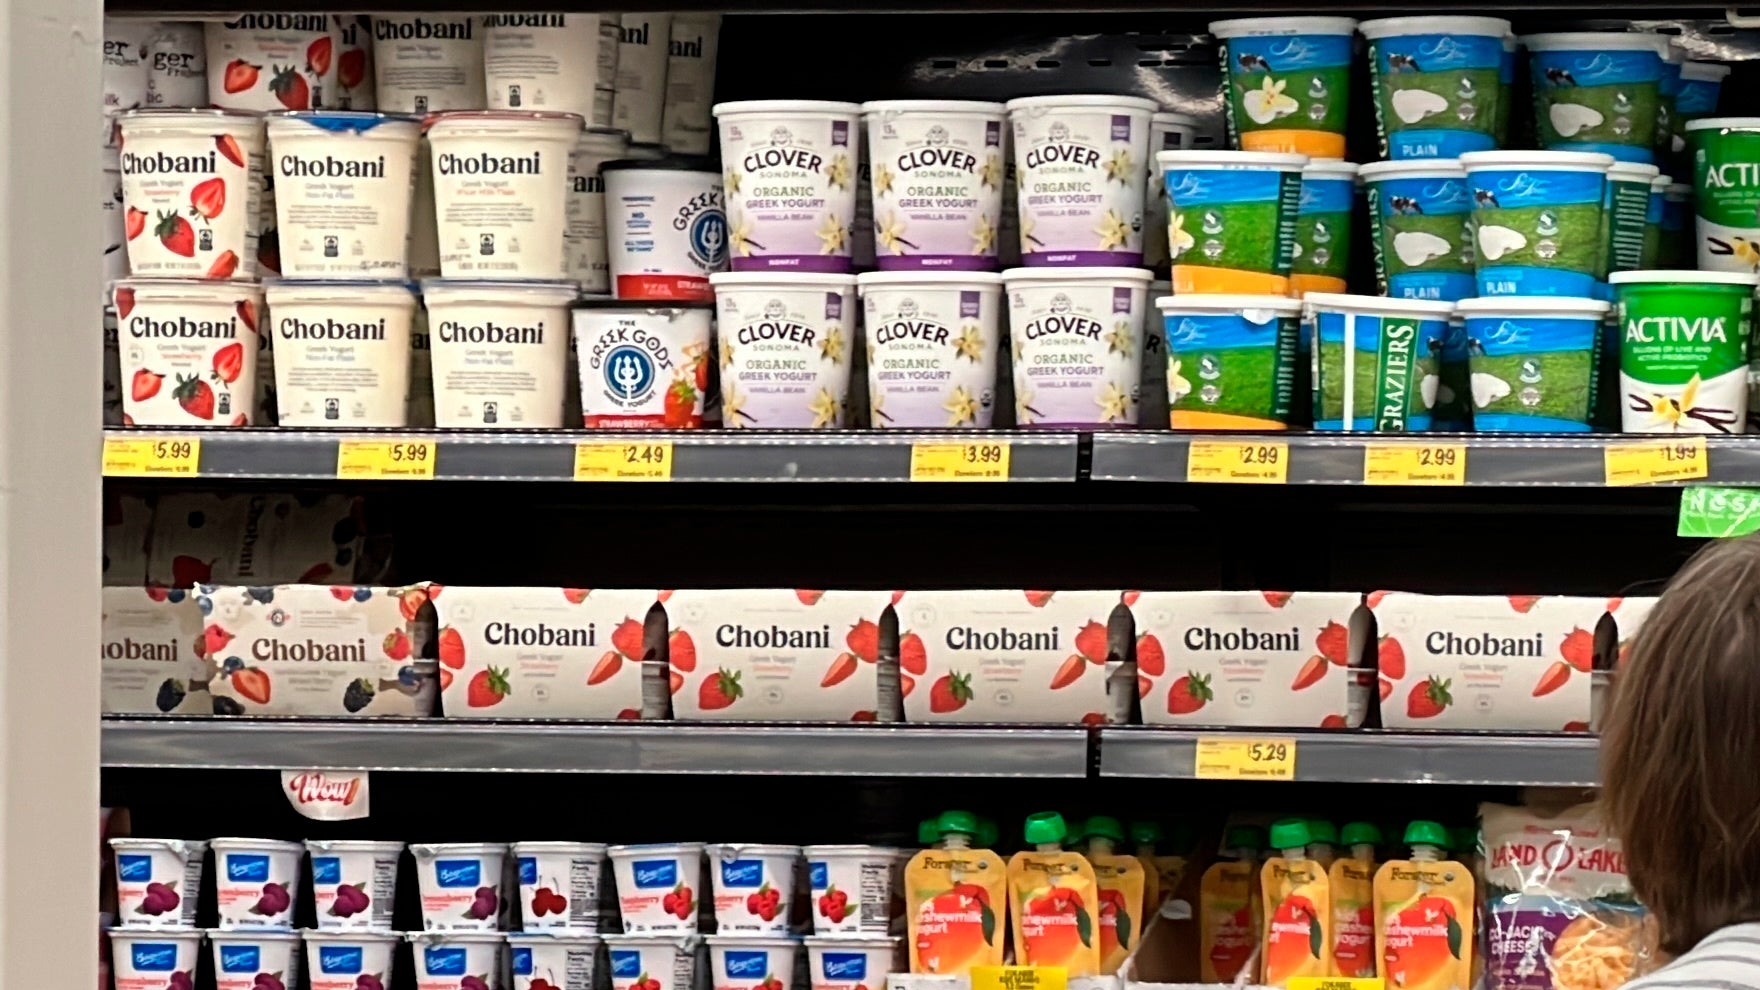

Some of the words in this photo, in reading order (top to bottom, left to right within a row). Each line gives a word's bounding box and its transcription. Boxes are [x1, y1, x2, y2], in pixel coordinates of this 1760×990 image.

[376, 18, 472, 40] Chobani
[123, 150, 216, 175] Chobani
[744, 149, 822, 174] CLOVER
[898, 149, 976, 174] CLOVER
[1026, 145, 1101, 170] CLOVER
[1402, 144, 1438, 157] PLAIN
[281, 154, 385, 179] Chobani
[439, 151, 540, 176] Chobani
[753, 186, 815, 198] ORGANIC
[907, 186, 969, 198] ORGANIC
[1033, 182, 1092, 194] ORGANIC
[1060, 194, 1102, 204] YOGURT
[779, 199, 825, 209] YOGURT
[933, 199, 978, 209] YOGURT
[1487, 282, 1516, 295] PLAIN
[130, 315, 237, 339] Chobani
[281, 318, 385, 342] Chobani
[439, 320, 544, 345] Chobani
[738, 321, 816, 347] CLOVER
[876, 321, 949, 346] CLOVER
[1026, 316, 1102, 341] CLOVER
[1626, 317, 1727, 343] ACTIVIA
[745, 359, 807, 370] ORGANIC
[883, 358, 940, 370] ORGANIC
[1033, 353, 1094, 365] ORGANIC
[1060, 365, 1104, 376] YOGURT
[772, 371, 817, 381] YOGURT
[908, 371, 951, 381] YOGURT
[1379, 323, 1415, 432] GRAZIERS
[153, 442, 191, 460] $5.99
[388, 444, 428, 462] $5.99
[623, 446, 664, 464] $2.49
[963, 445, 1001, 463] $3.99
[485, 622, 596, 648] Chobani
[716, 624, 830, 649] Chobani
[946, 627, 1059, 652] Chobani
[1184, 627, 1299, 652] Chobani
[1425, 631, 1543, 657] Chobani
[252, 637, 366, 662] Chobani
[1248, 742, 1287, 762] $5.29
[290, 773, 360, 804] Wow!
